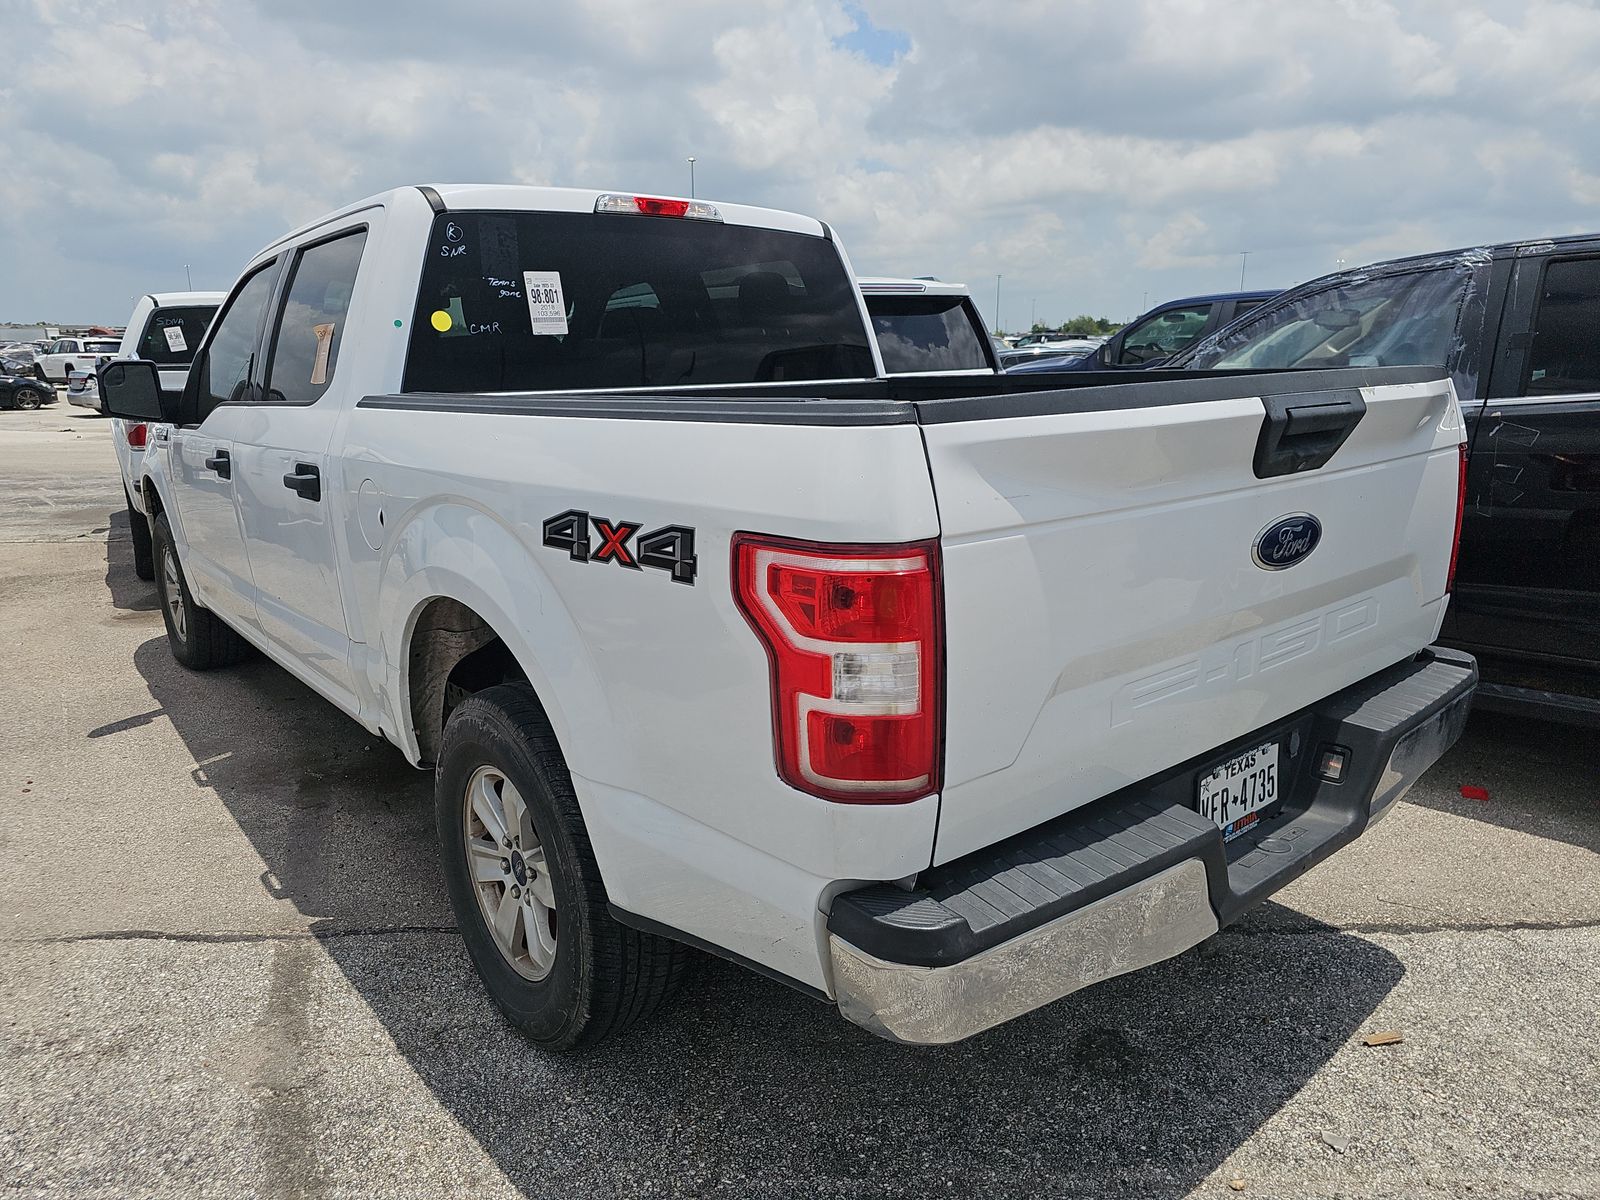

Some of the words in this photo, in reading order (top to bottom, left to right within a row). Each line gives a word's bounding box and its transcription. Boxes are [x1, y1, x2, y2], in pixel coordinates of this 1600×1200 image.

[530, 288, 560, 304] 98:801
[1272, 524, 1312, 560] Ford
[1110, 596, 1380, 728] F-150
[1224, 754, 1257, 780] TEXAS
